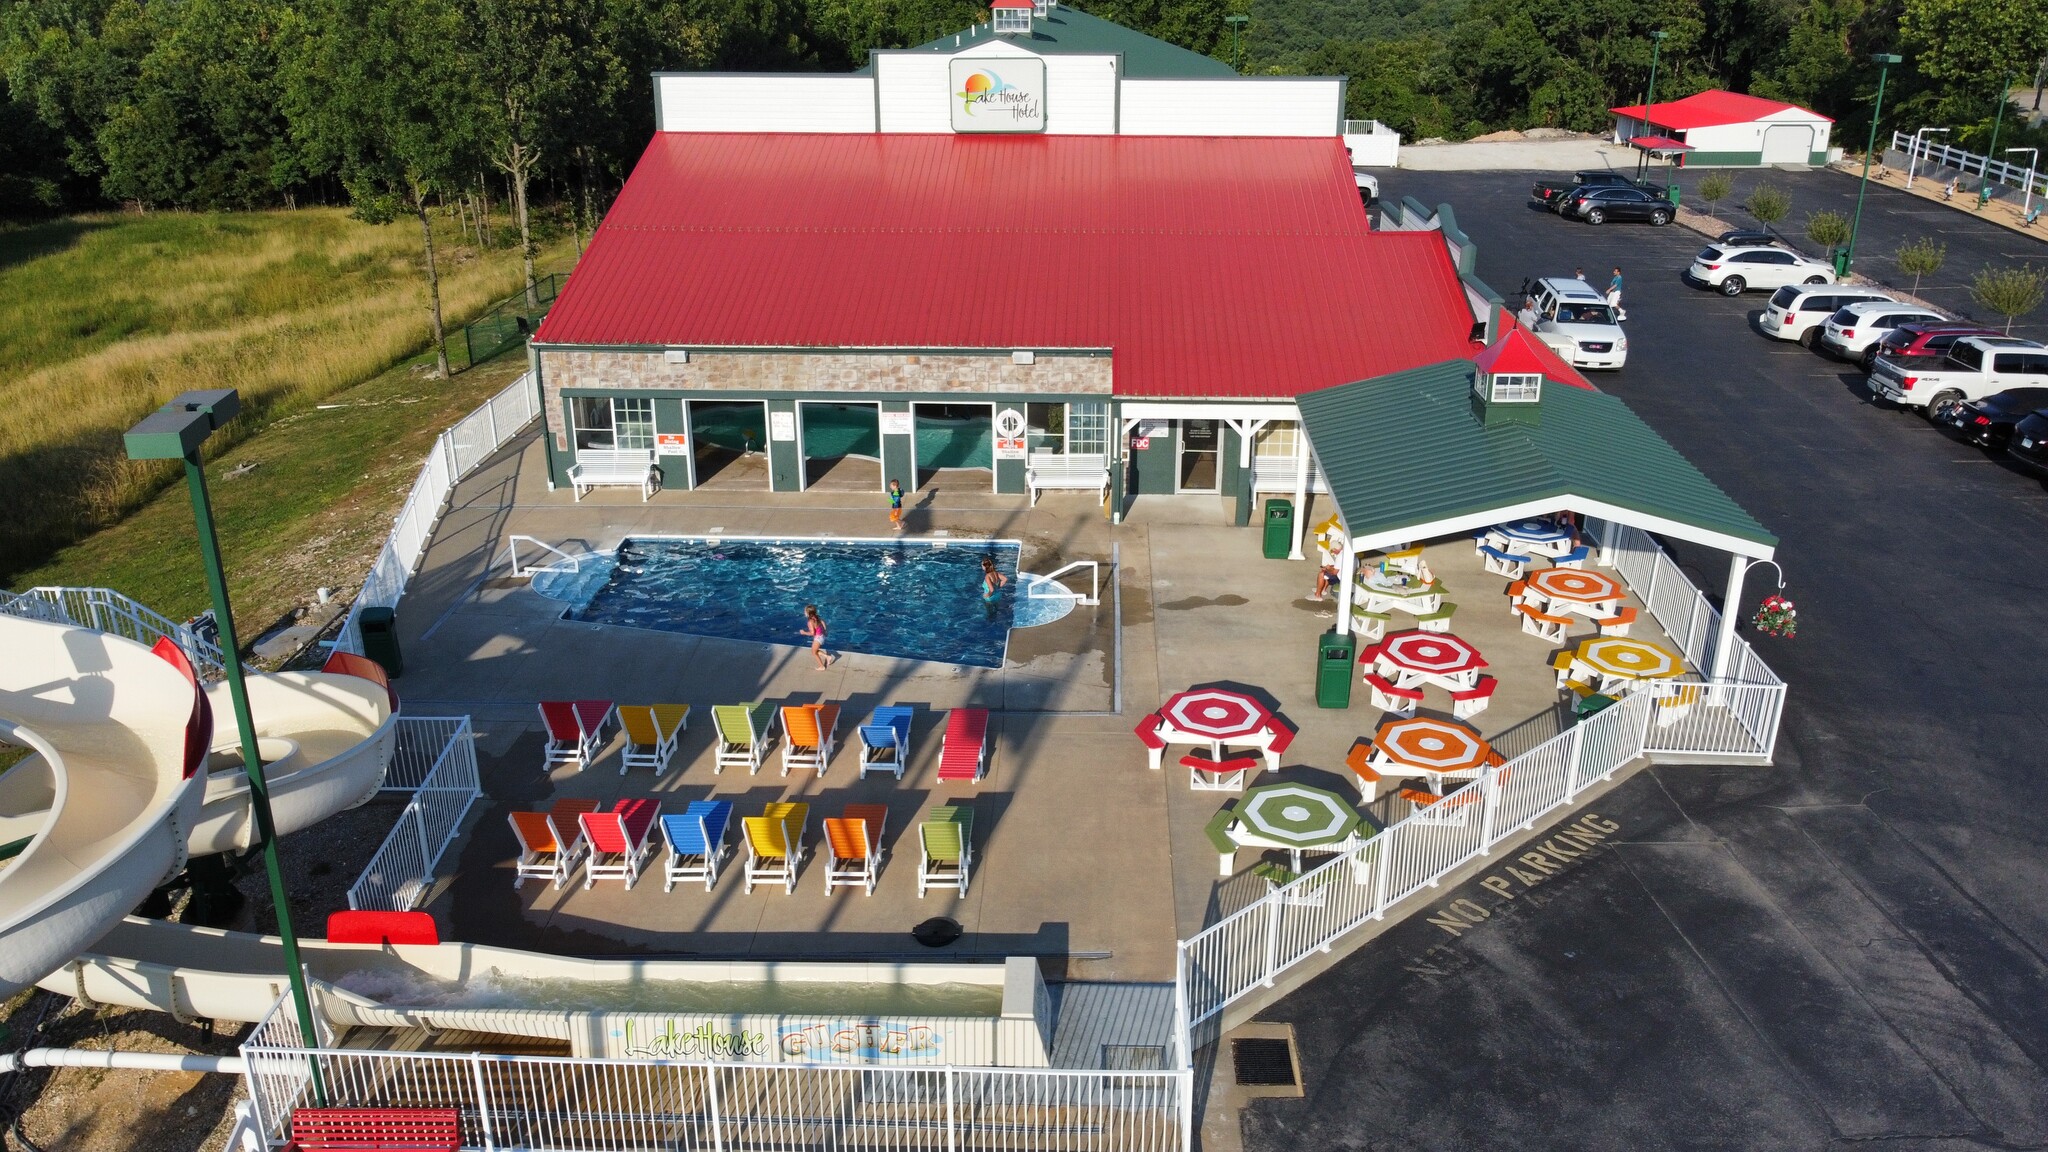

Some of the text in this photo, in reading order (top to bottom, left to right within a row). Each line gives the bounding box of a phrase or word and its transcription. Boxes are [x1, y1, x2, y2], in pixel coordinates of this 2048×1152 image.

[965, 87, 1031, 105] Lake House
[1012, 99, 1040, 122] Hotel
[1131, 437, 1149, 448] FDC
[1426, 898, 1491, 937] NO
[1479, 813, 1620, 900] PARKING
[780, 1023, 938, 1056] GUSHER
